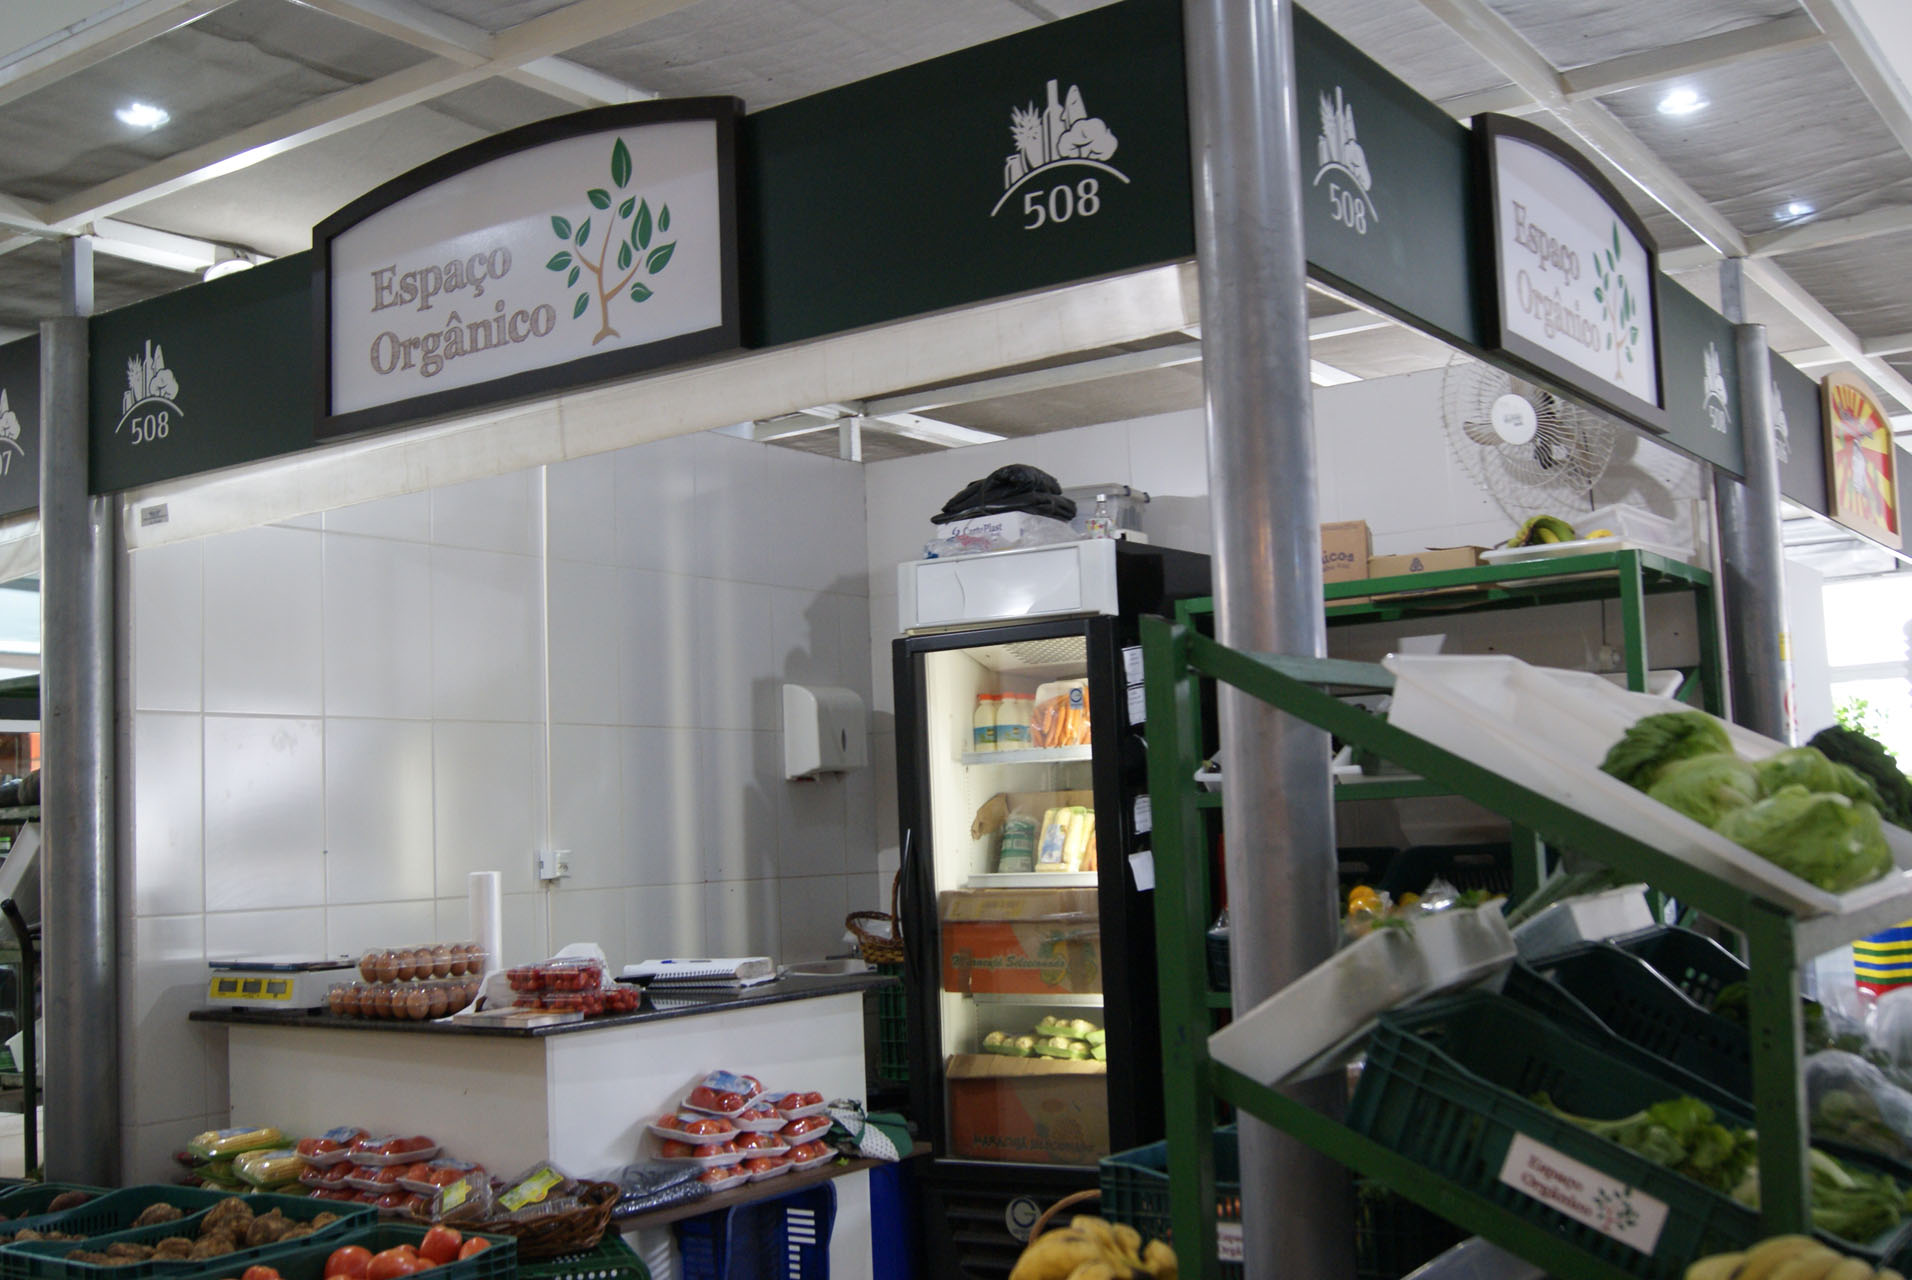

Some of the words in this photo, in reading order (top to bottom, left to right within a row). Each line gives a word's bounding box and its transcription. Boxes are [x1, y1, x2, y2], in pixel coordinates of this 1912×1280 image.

[1023, 178, 1101, 230] 508
[1329, 182, 1367, 235] 508
[1512, 200, 1581, 287] Espaço
[370, 247, 512, 313] Espaço
[369, 299, 557, 378] Orgânico
[1517, 268, 1601, 353] Orgânico
[131, 410, 169, 445] 508
[0, 449, 12, 476] 7
